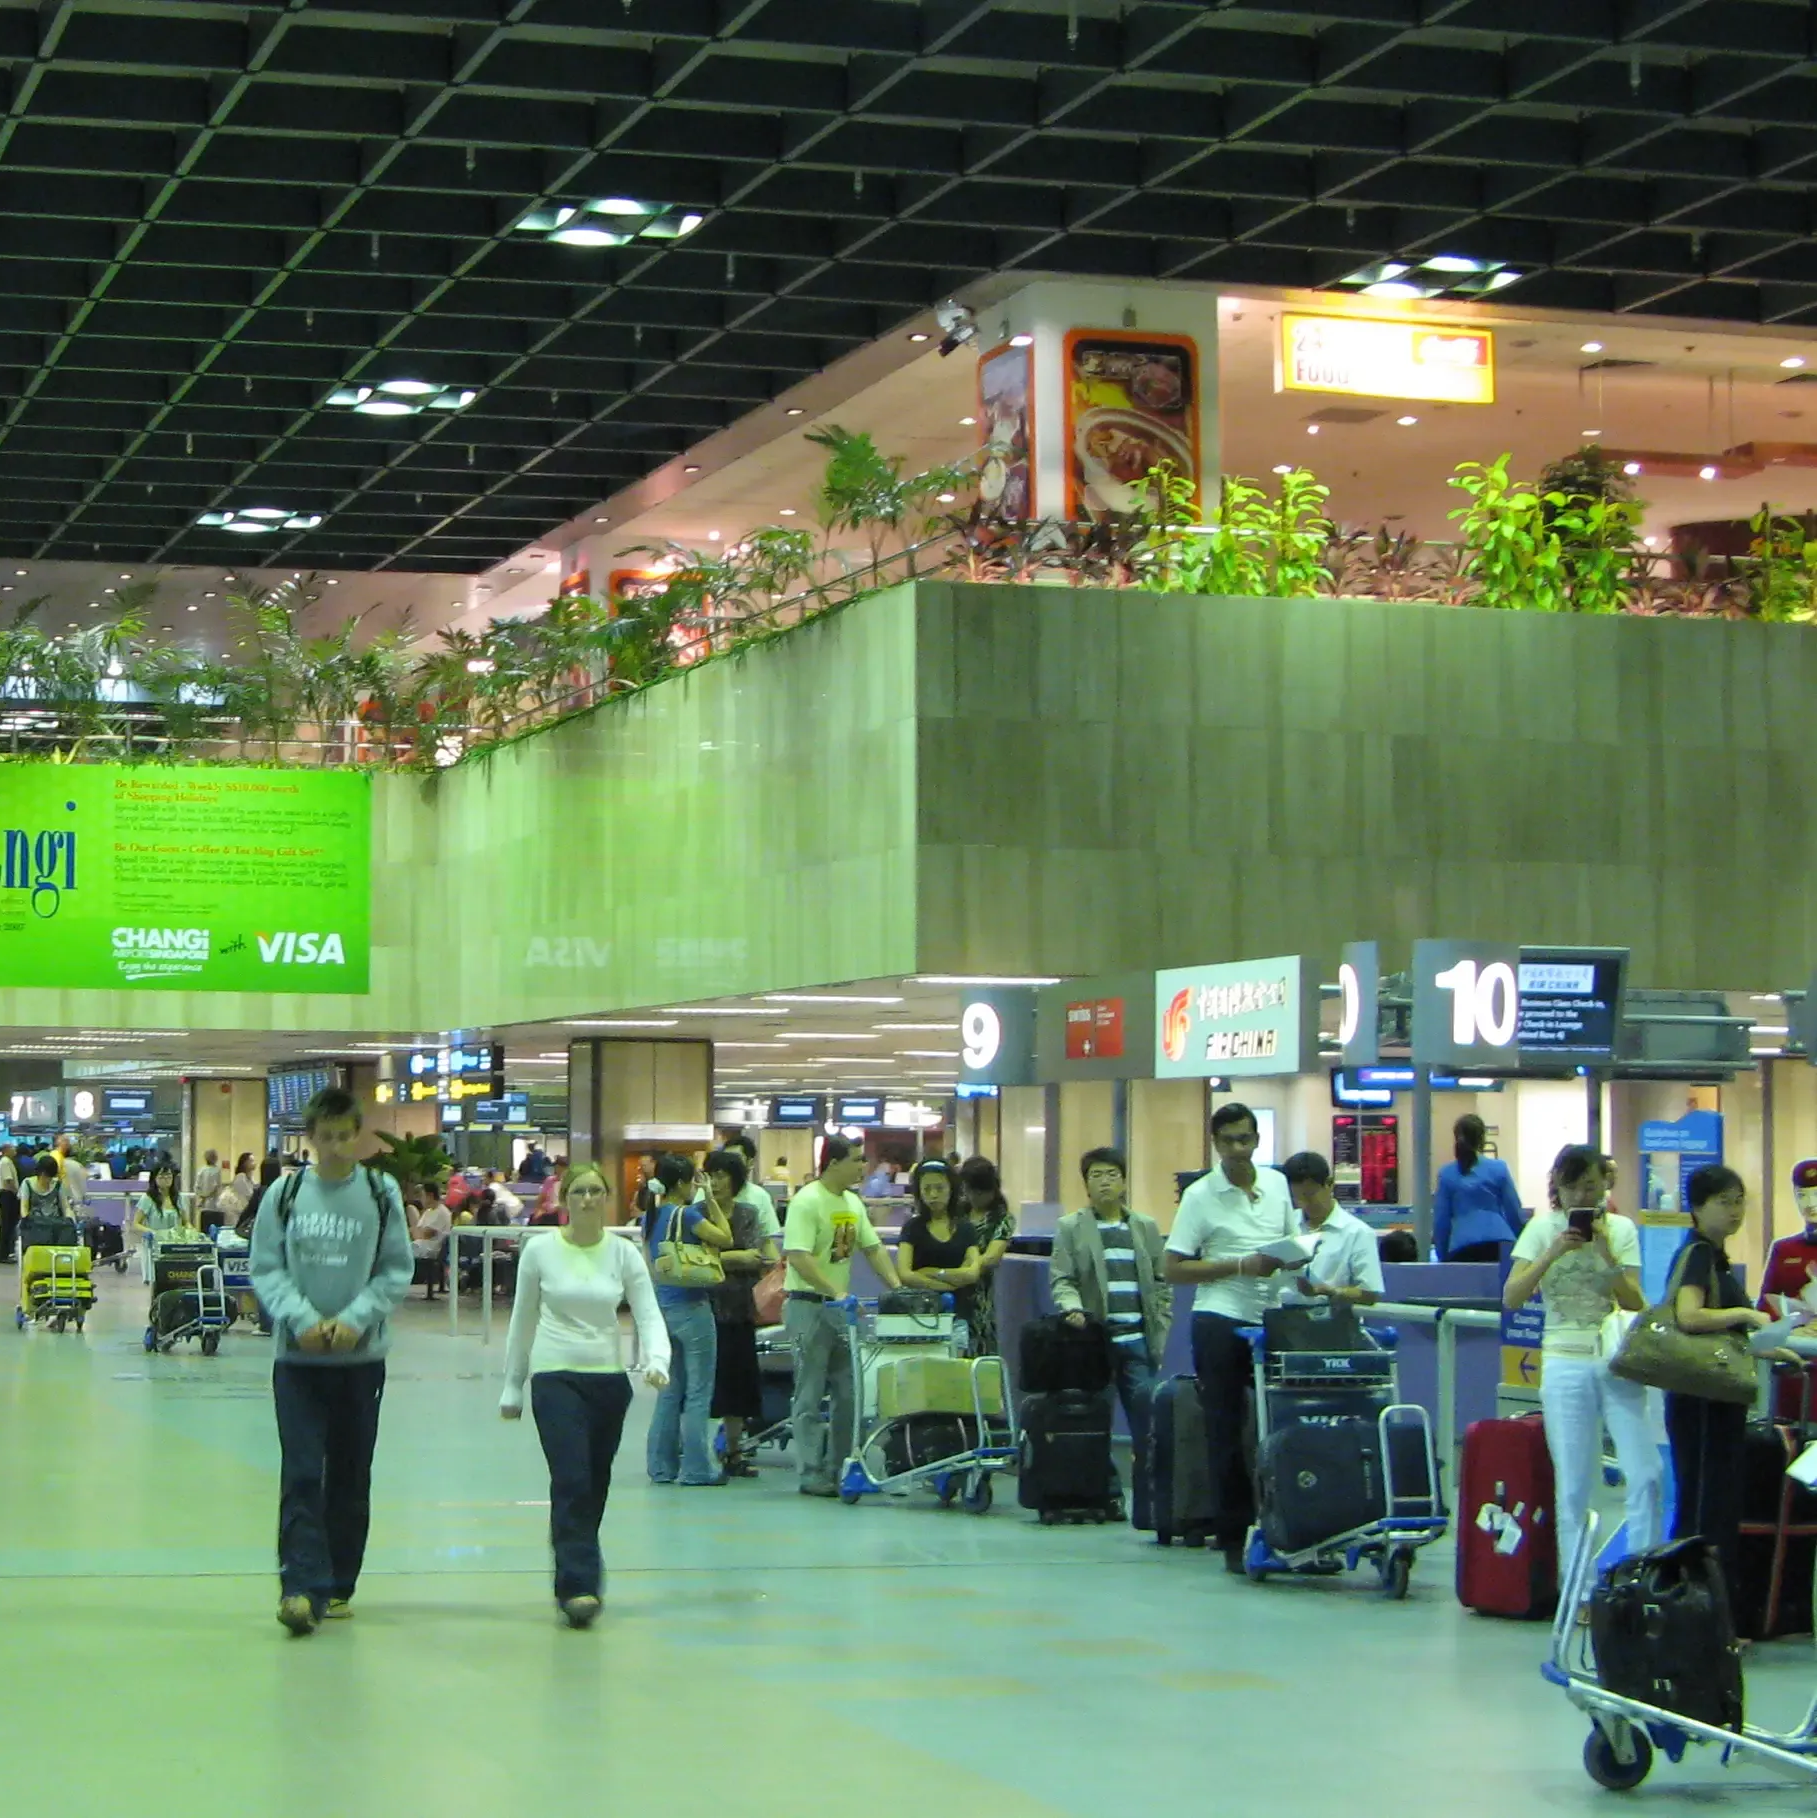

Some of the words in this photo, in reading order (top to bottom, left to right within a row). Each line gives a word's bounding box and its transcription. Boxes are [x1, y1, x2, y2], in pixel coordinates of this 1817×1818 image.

[257, 932, 345, 964] VISA
[1435, 960, 1518, 1046] 10
[962, 1002, 1001, 1069] 9
[74, 1091, 94, 1119] 8
[227, 1259, 250, 1272] VIS
